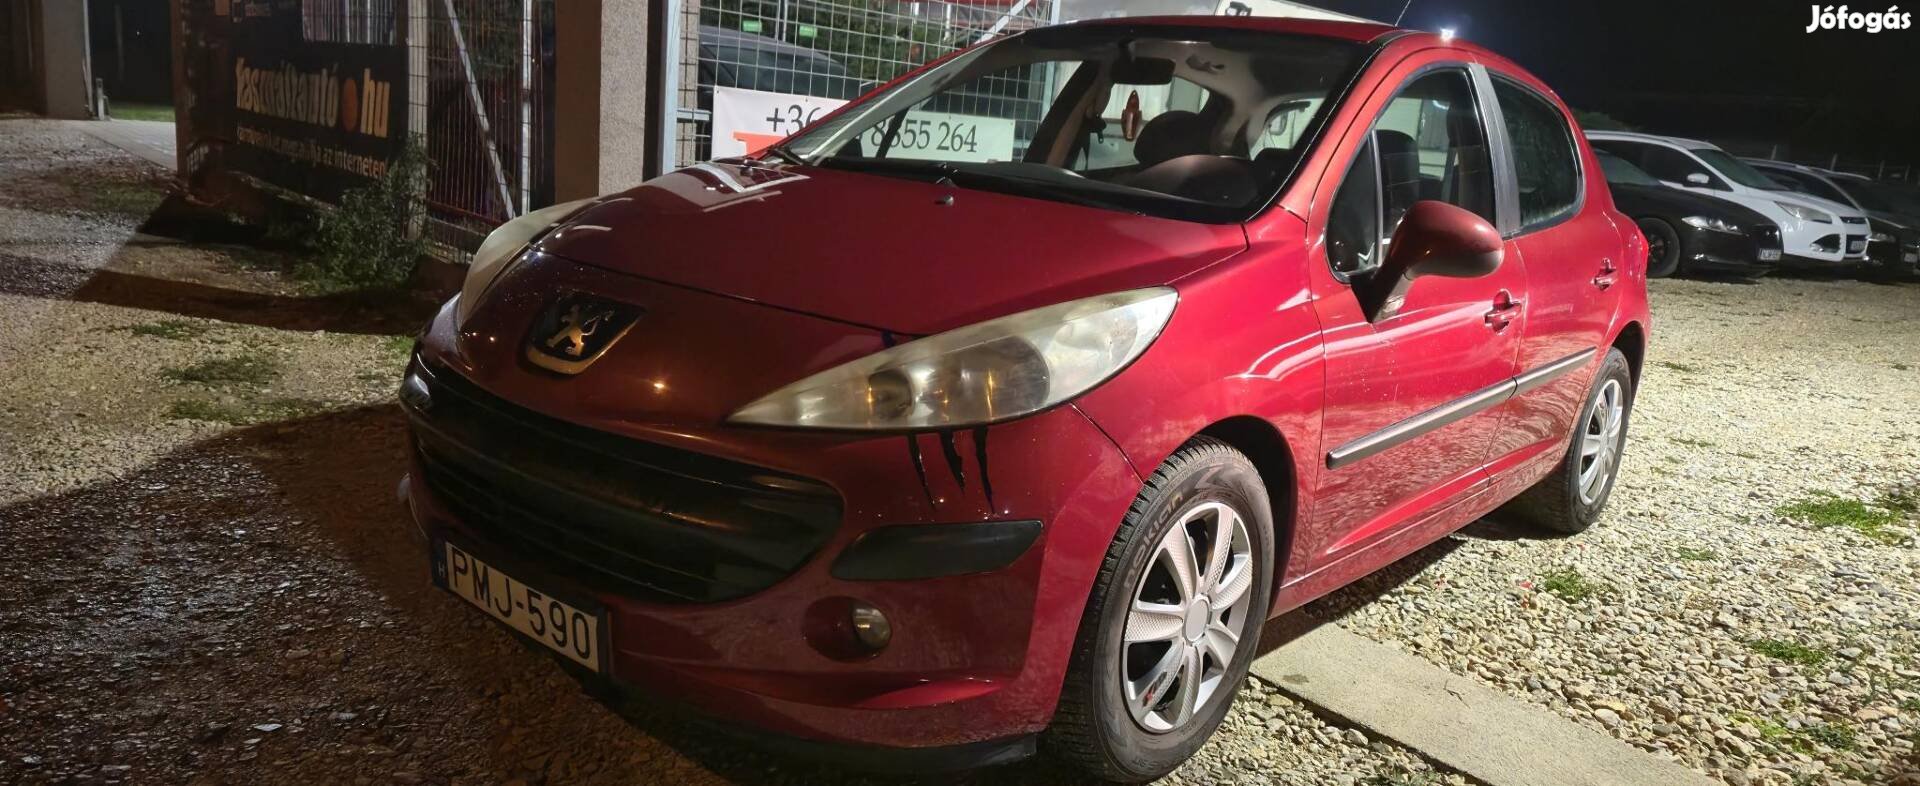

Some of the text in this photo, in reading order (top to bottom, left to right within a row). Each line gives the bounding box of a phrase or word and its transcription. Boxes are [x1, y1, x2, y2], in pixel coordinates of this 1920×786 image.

[936, 121, 977, 152] 264
[438, 563, 446, 577] H
[451, 549, 591, 660] PMJ-590
